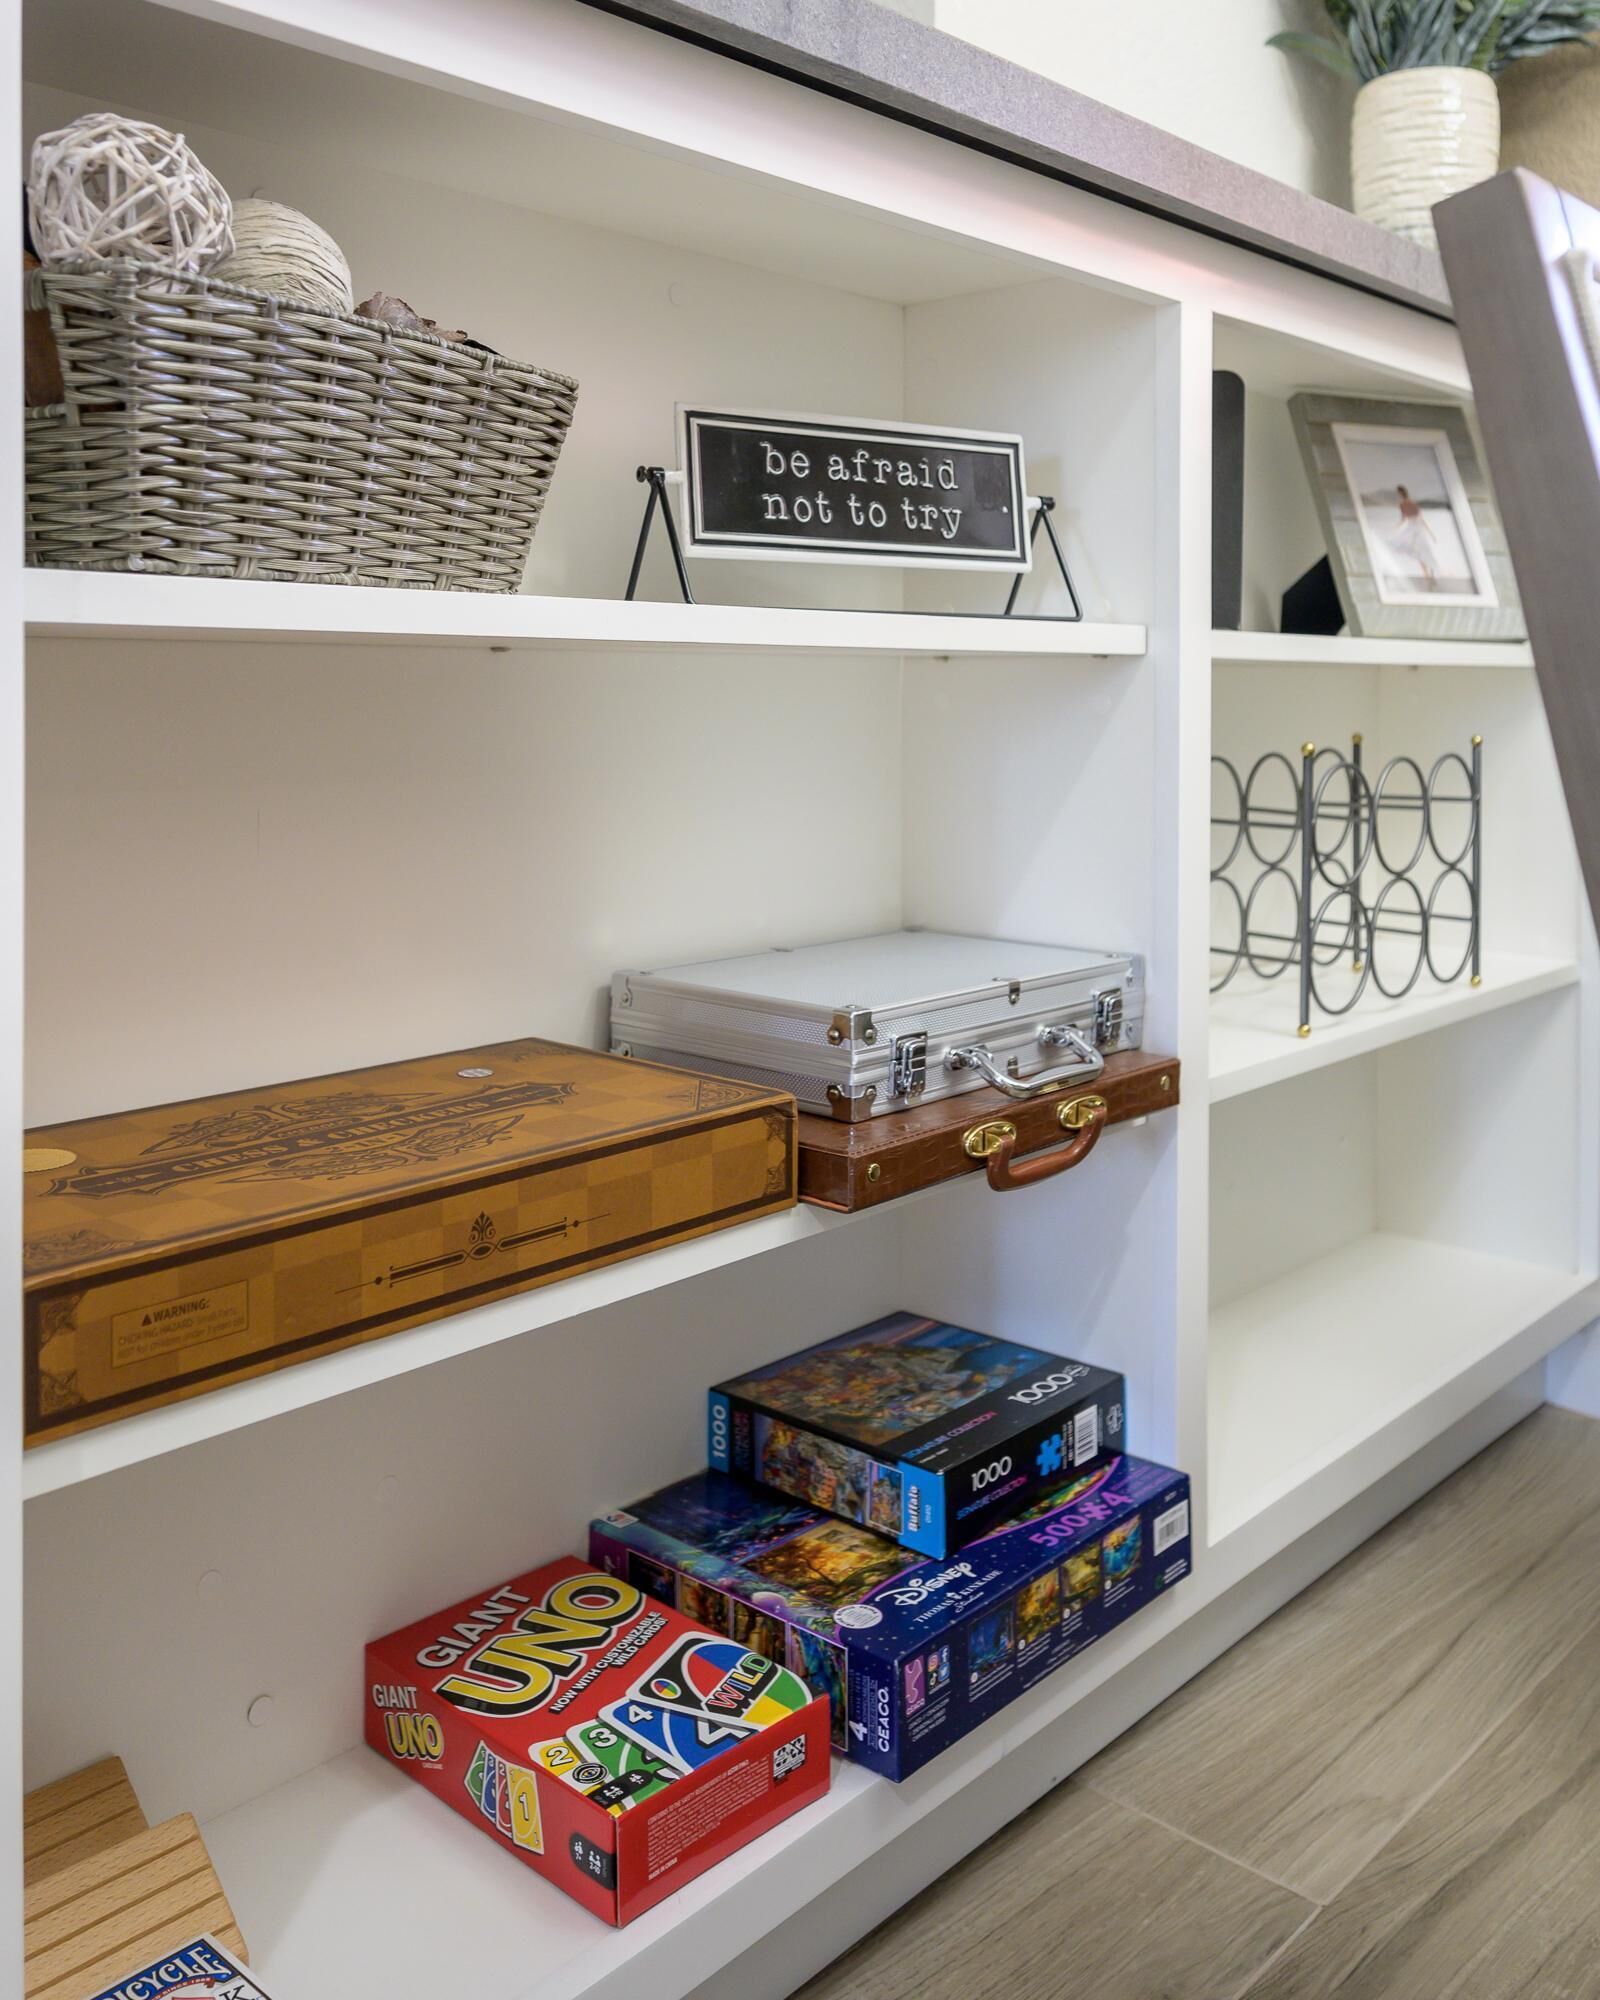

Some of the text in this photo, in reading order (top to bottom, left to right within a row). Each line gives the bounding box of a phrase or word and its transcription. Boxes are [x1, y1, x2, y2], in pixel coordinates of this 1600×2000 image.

[760, 441, 959, 491] be afraid
[762, 490, 962, 539] not to try
[171, 1143, 289, 1174] CHESS
[327, 1101, 490, 1141] CHECKERS
[153, 1298, 209, 1322] WARNING:
[1007, 1372, 1074, 1405] 1000
[712, 1404, 727, 1458] 1000
[971, 1456, 1013, 1492] 1000
[907, 1486, 920, 1532] Buffalo
[1029, 1514, 1090, 1547] 500
[874, 1562, 977, 1607] Disney
[415, 1585, 531, 1669] GIANT
[434, 1573, 645, 1718] UNO
[611, 1617, 669, 1667] WILD CARDS!
[550, 1610, 662, 1711] NOW WITH CUSTOMIZABLE
[707, 1653, 774, 1709] WILD
[372, 1684, 417, 1710] GIANT
[627, 1703, 654, 1725] 4
[384, 1712, 445, 1762] UNO
[587, 1726, 618, 1749] 3
[848, 1720, 868, 1742] 4
[546, 1746, 575, 1768] 2
[519, 1792, 530, 1821] 1
[102, 1946, 232, 2000] CYCLE
